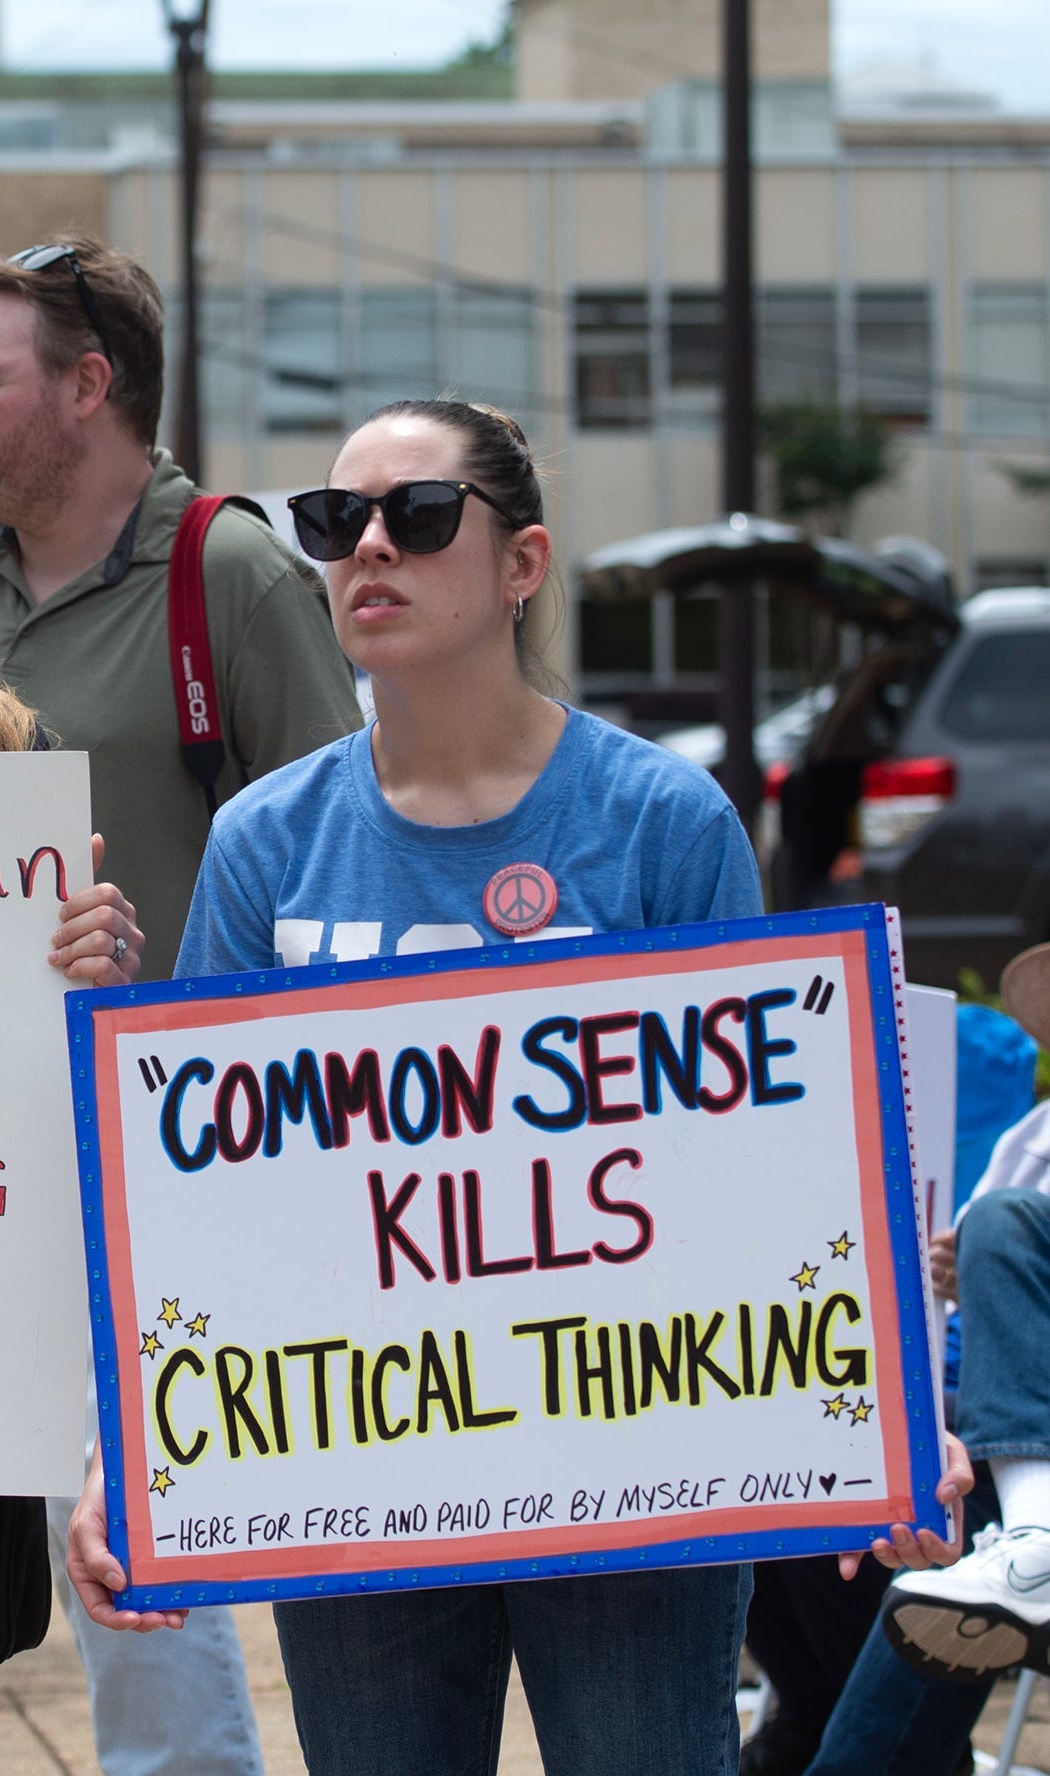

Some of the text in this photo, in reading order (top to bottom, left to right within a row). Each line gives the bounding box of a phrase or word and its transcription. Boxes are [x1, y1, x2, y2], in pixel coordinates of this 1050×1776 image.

[187, 681, 210, 735] EOS
[138, 975, 835, 1173] "COMMON SENSE"
[367, 1147, 654, 1290] KILLS
[153, 1292, 868, 1467] CRITICAL THINKING
[247, 1512, 294, 1545] FOR
[304, 1506, 371, 1539] FREE
[384, 1504, 427, 1537] AND
[437, 1498, 490, 1532] PAID
[503, 1493, 554, 1529] FOR
[570, 1490, 605, 1522] BY
[616, 1478, 726, 1517] MYSELF
